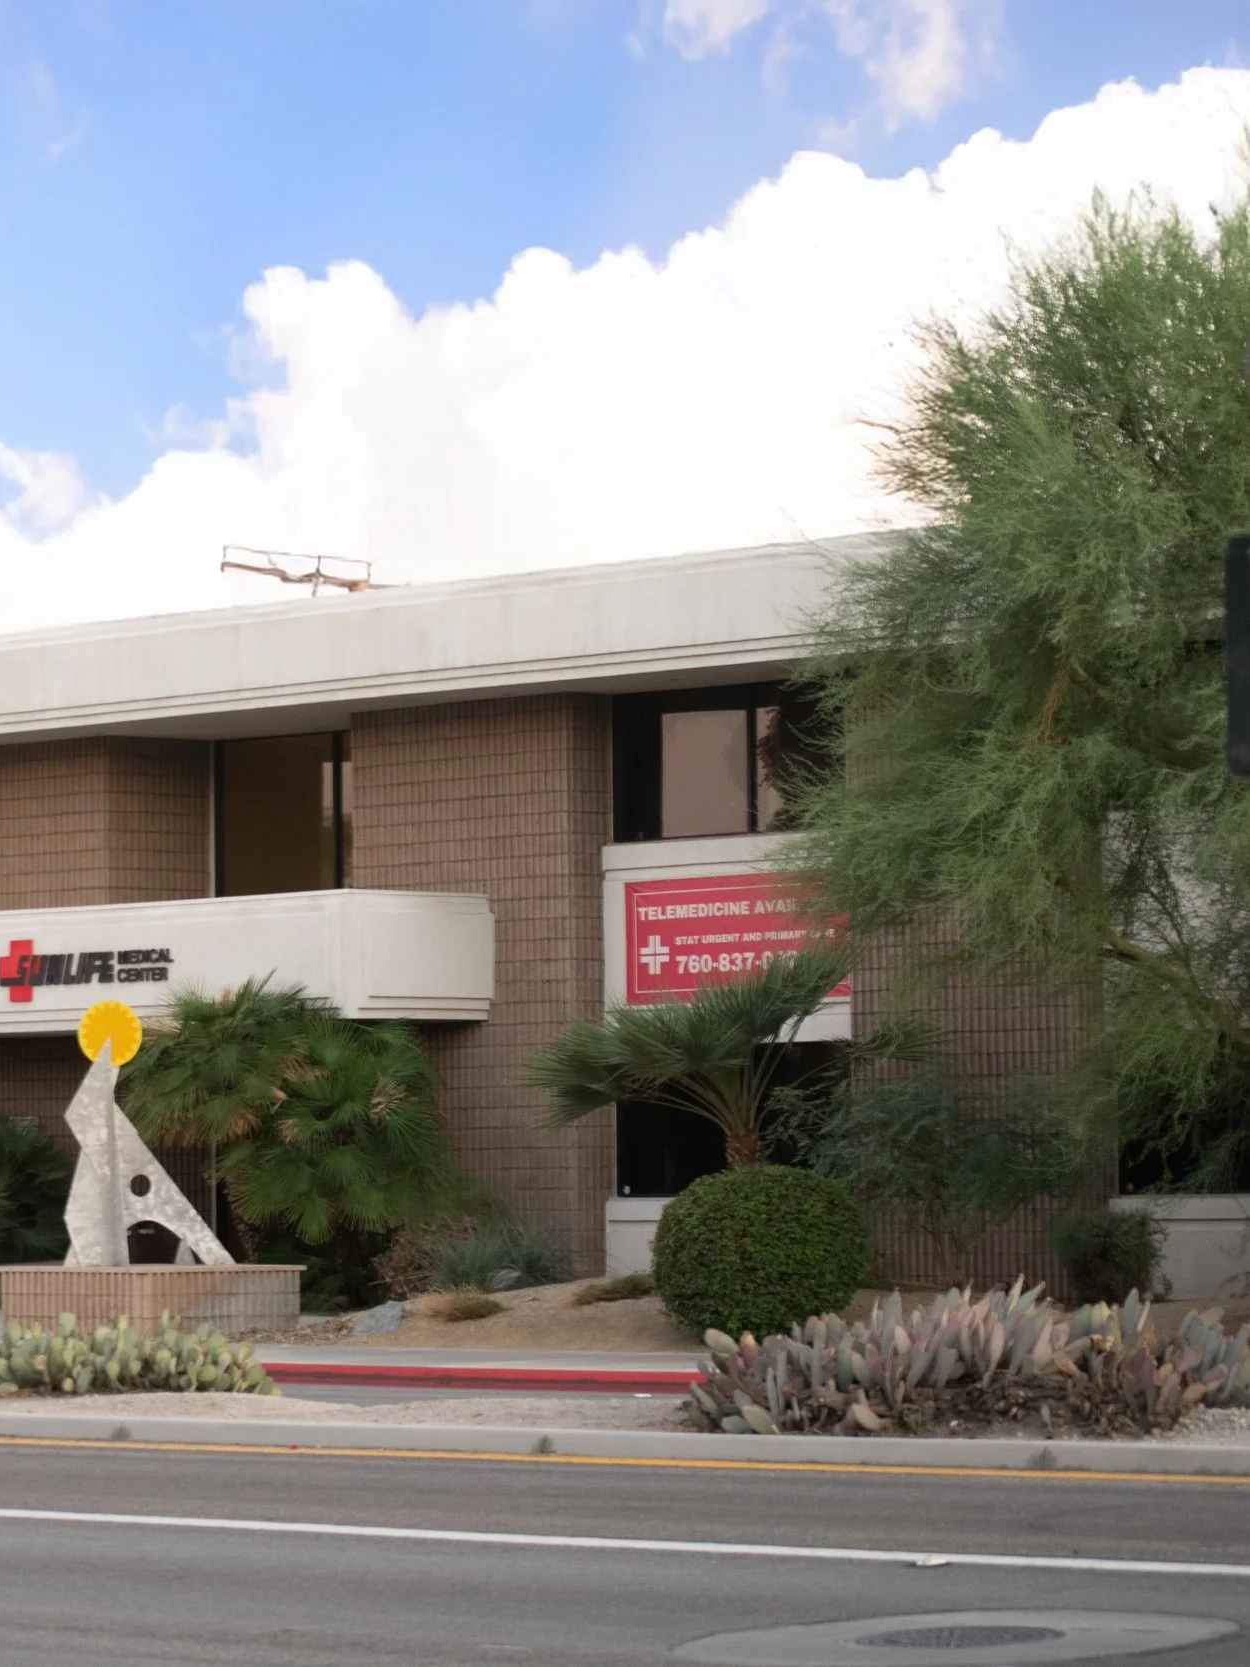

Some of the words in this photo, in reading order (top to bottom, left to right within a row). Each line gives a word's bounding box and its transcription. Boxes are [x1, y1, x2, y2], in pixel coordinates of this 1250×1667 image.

[638, 901, 750, 920] TELEMEDICINE
[675, 935, 700, 945] STAT
[702, 933, 741, 944] URGENT
[743, 932, 763, 942] AND
[765, 929, 808, 940] PRIMARY
[117, 948, 174, 965] MEDICAL
[0, 951, 115, 987] SUNLIFE
[117, 967, 169, 983] CENTER
